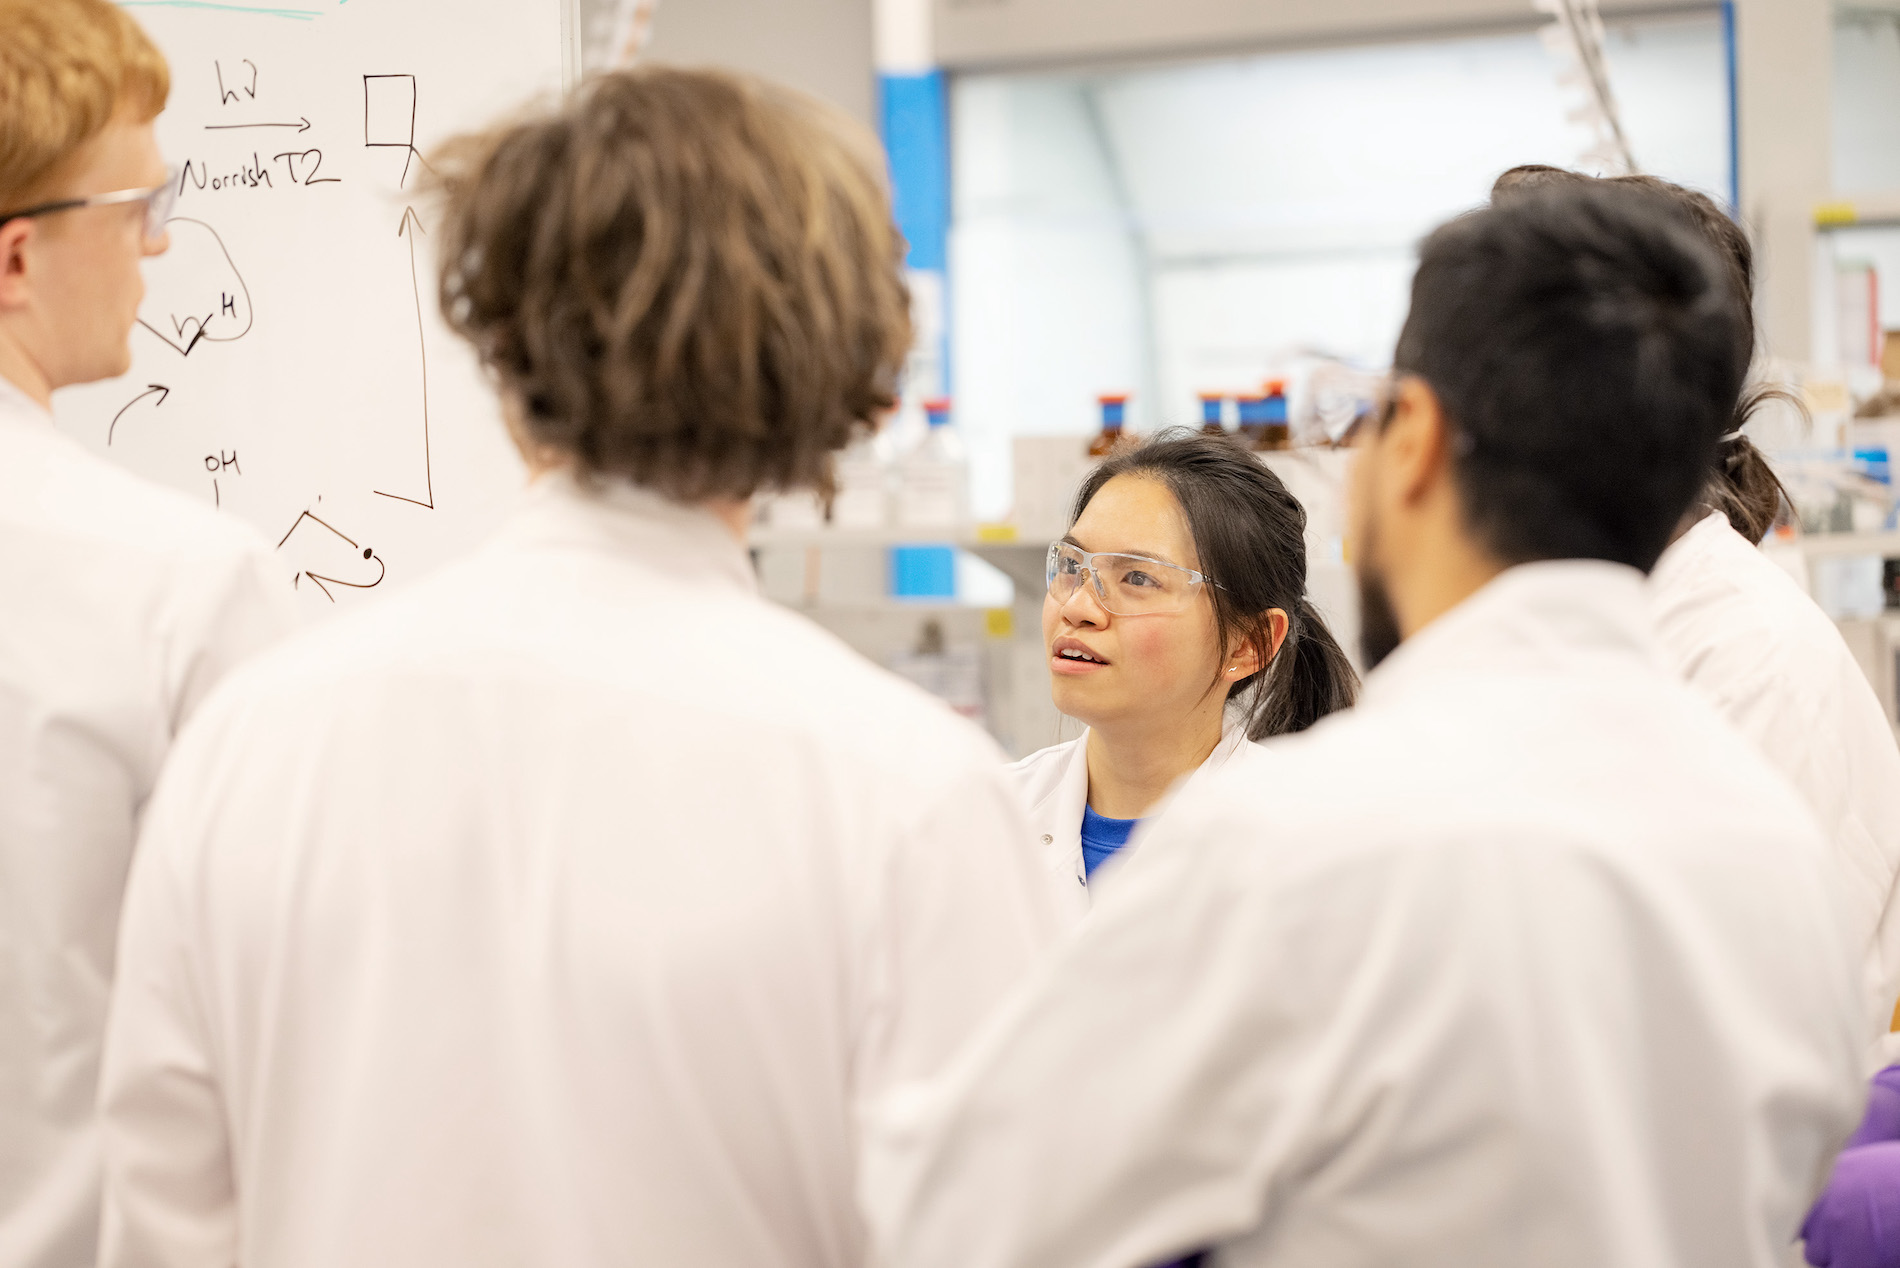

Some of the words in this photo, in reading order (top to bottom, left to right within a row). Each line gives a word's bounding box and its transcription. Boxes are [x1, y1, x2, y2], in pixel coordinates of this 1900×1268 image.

[178, 151, 274, 197] Norrish
[221, 291, 237, 319] H
[204, 449, 241, 475] OH
